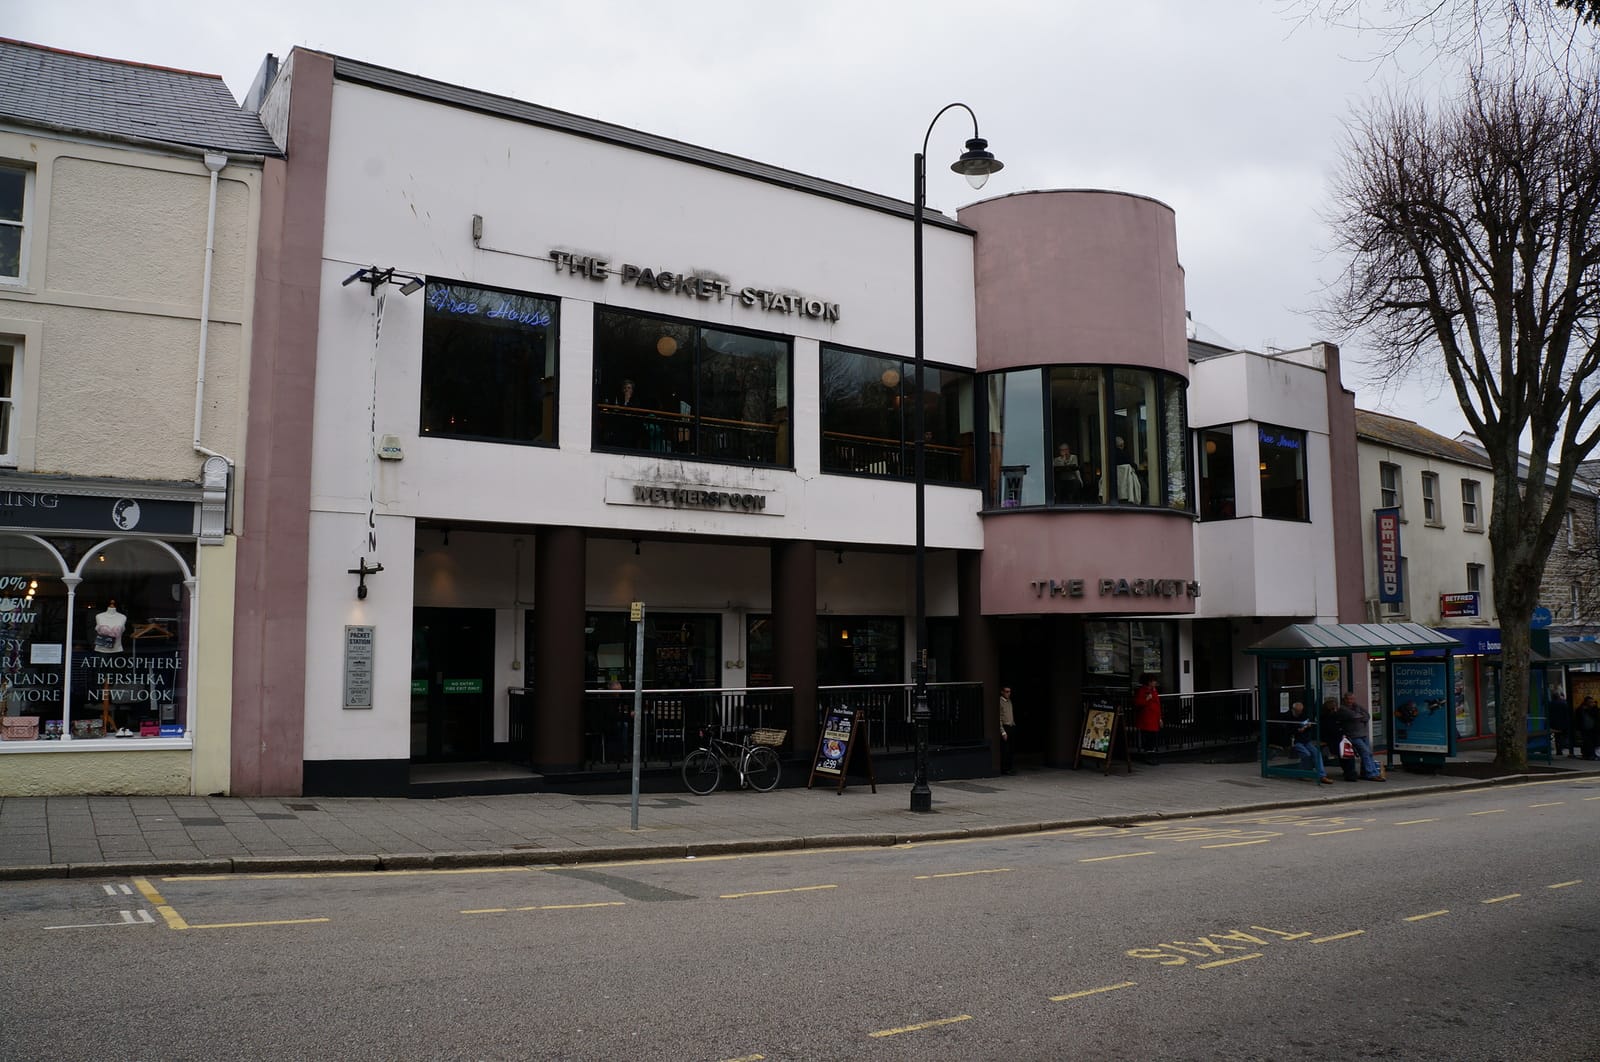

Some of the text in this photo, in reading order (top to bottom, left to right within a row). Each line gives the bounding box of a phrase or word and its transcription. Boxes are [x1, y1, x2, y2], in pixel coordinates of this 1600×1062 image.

[550, 250, 840, 323] THE PACKET STATION
[431, 287, 551, 328] Free House
[0, 491, 60, 508] ING
[632, 485, 767, 511] WETHERSPOON
[1380, 516, 1398, 596] BETFRED
[1031, 579, 1085, 597] THE
[1099, 578, 1187, 598] PACKET
[1445, 594, 1474, 602] BETFRED
[0, 612, 37, 624] OUNT
[80, 656, 183, 670] ATMOSPHERE
[97, 674, 166, 686] BERSHKA
[12, 689, 61, 702] MORE
[87, 690, 172, 702] NEW LOOK
[1124, 925, 1313, 967] TAXIS
